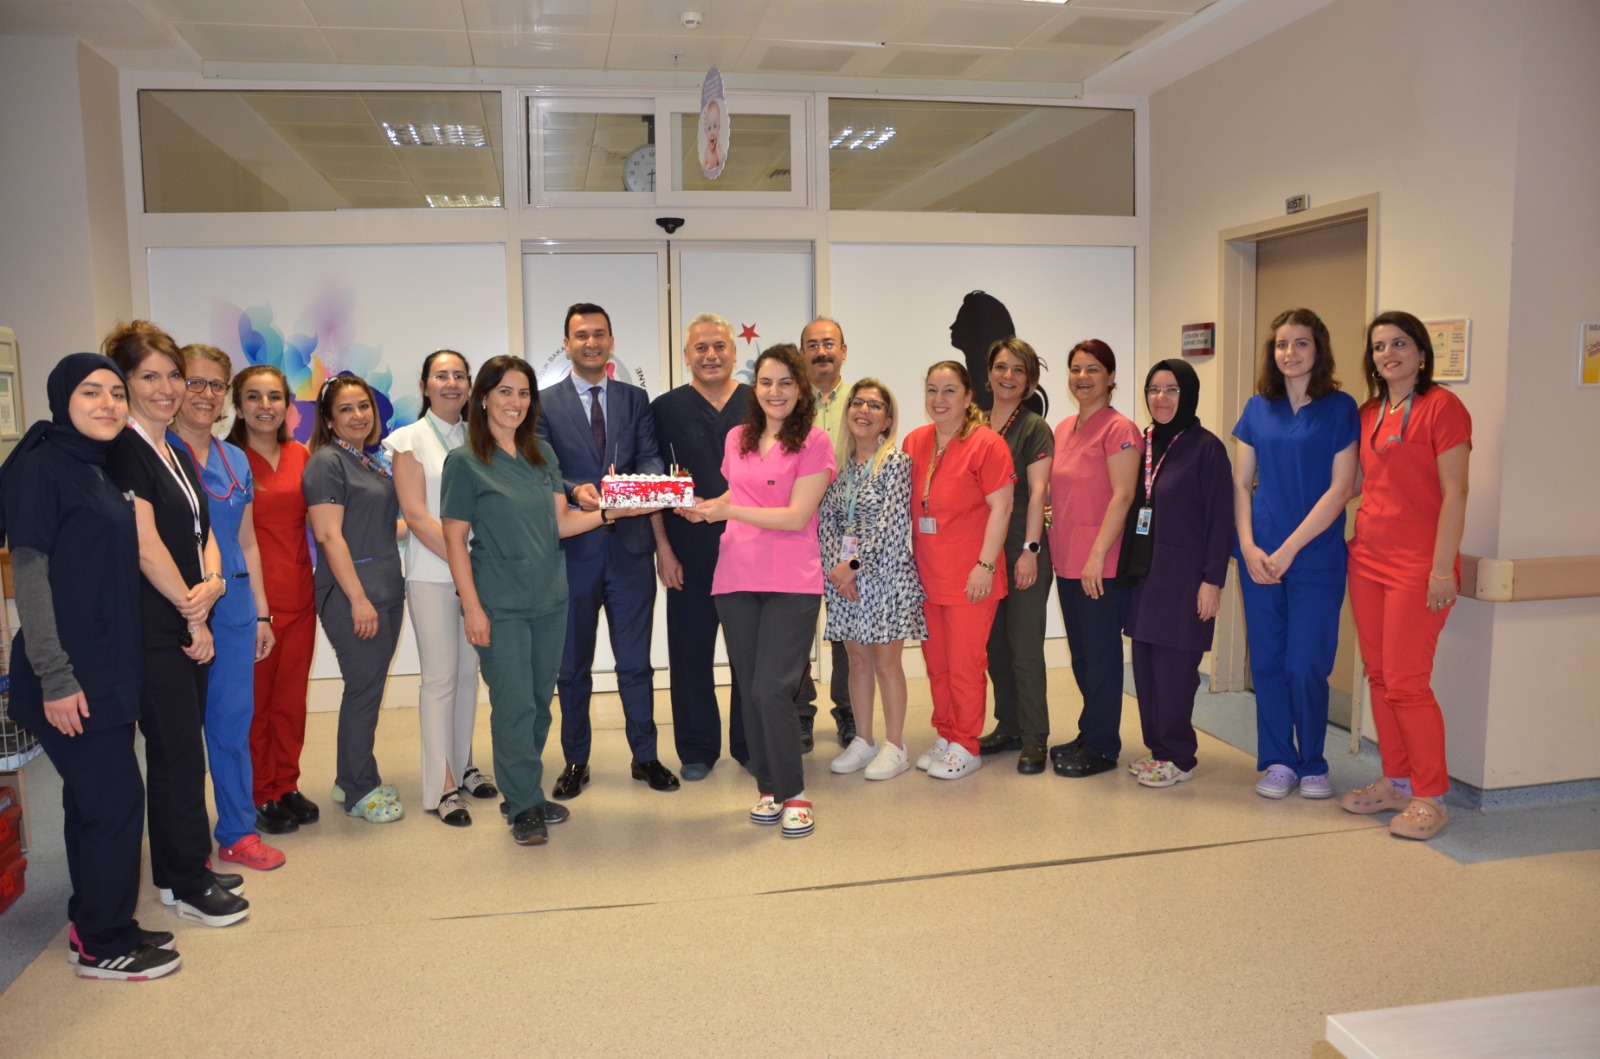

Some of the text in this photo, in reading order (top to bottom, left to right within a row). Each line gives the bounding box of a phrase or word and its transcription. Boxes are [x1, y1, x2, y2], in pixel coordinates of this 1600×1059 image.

[1287, 197, 1302, 209] 4057
[547, 346, 566, 362] BAKA
[635, 366, 646, 387] ANE
